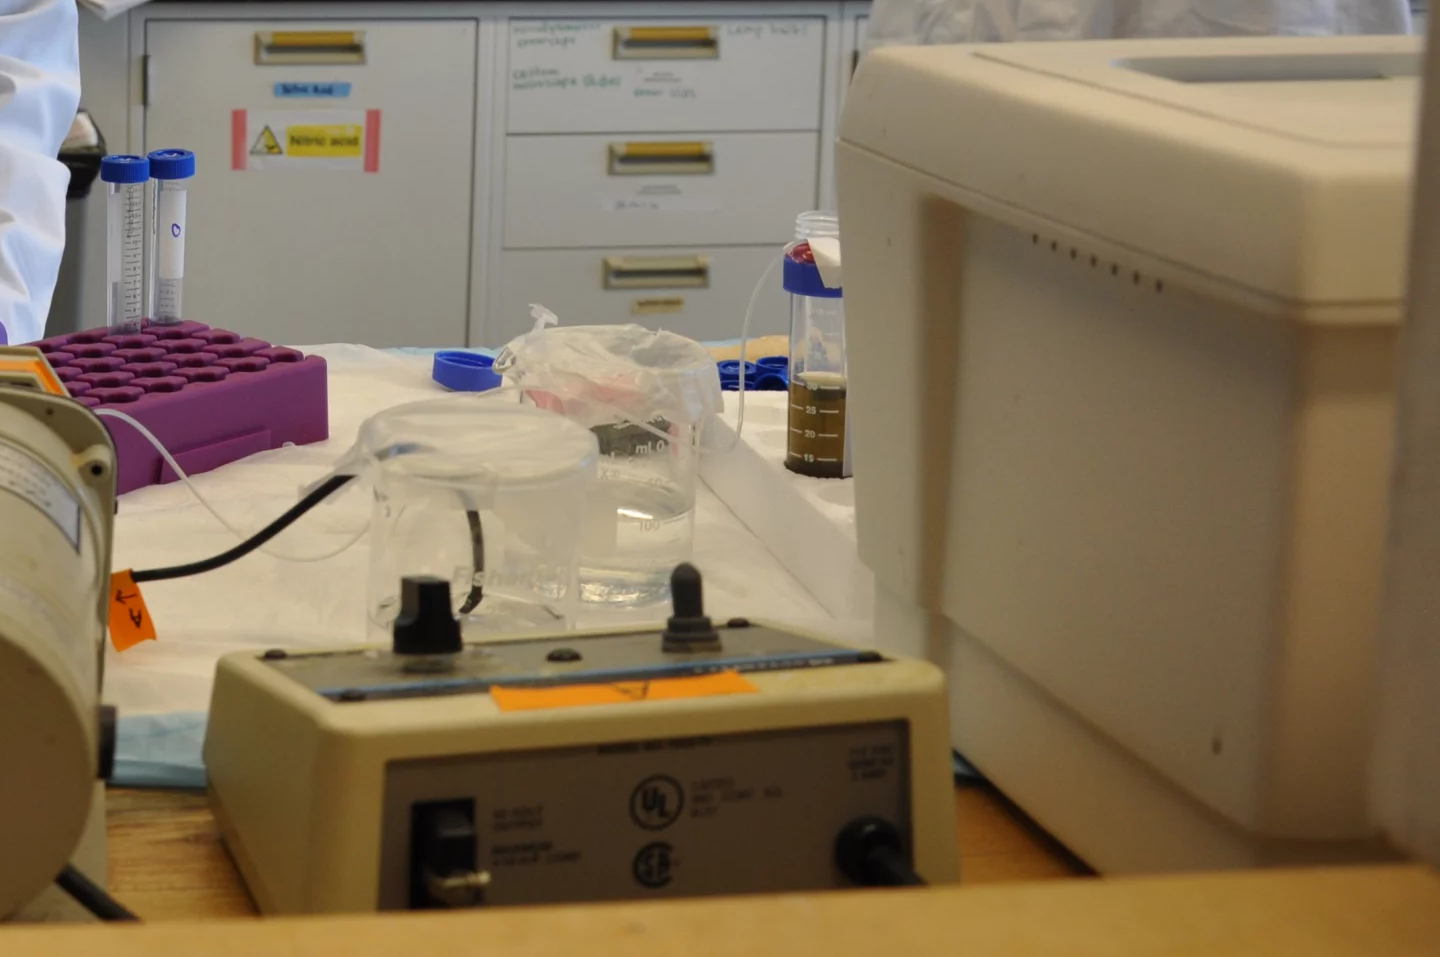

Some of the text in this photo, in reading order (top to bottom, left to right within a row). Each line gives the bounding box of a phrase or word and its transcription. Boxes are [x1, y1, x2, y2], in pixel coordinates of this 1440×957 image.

[290, 135, 359, 147] Nitric acid
[805, 405, 817, 415] 25
[804, 429, 816, 439] 20
